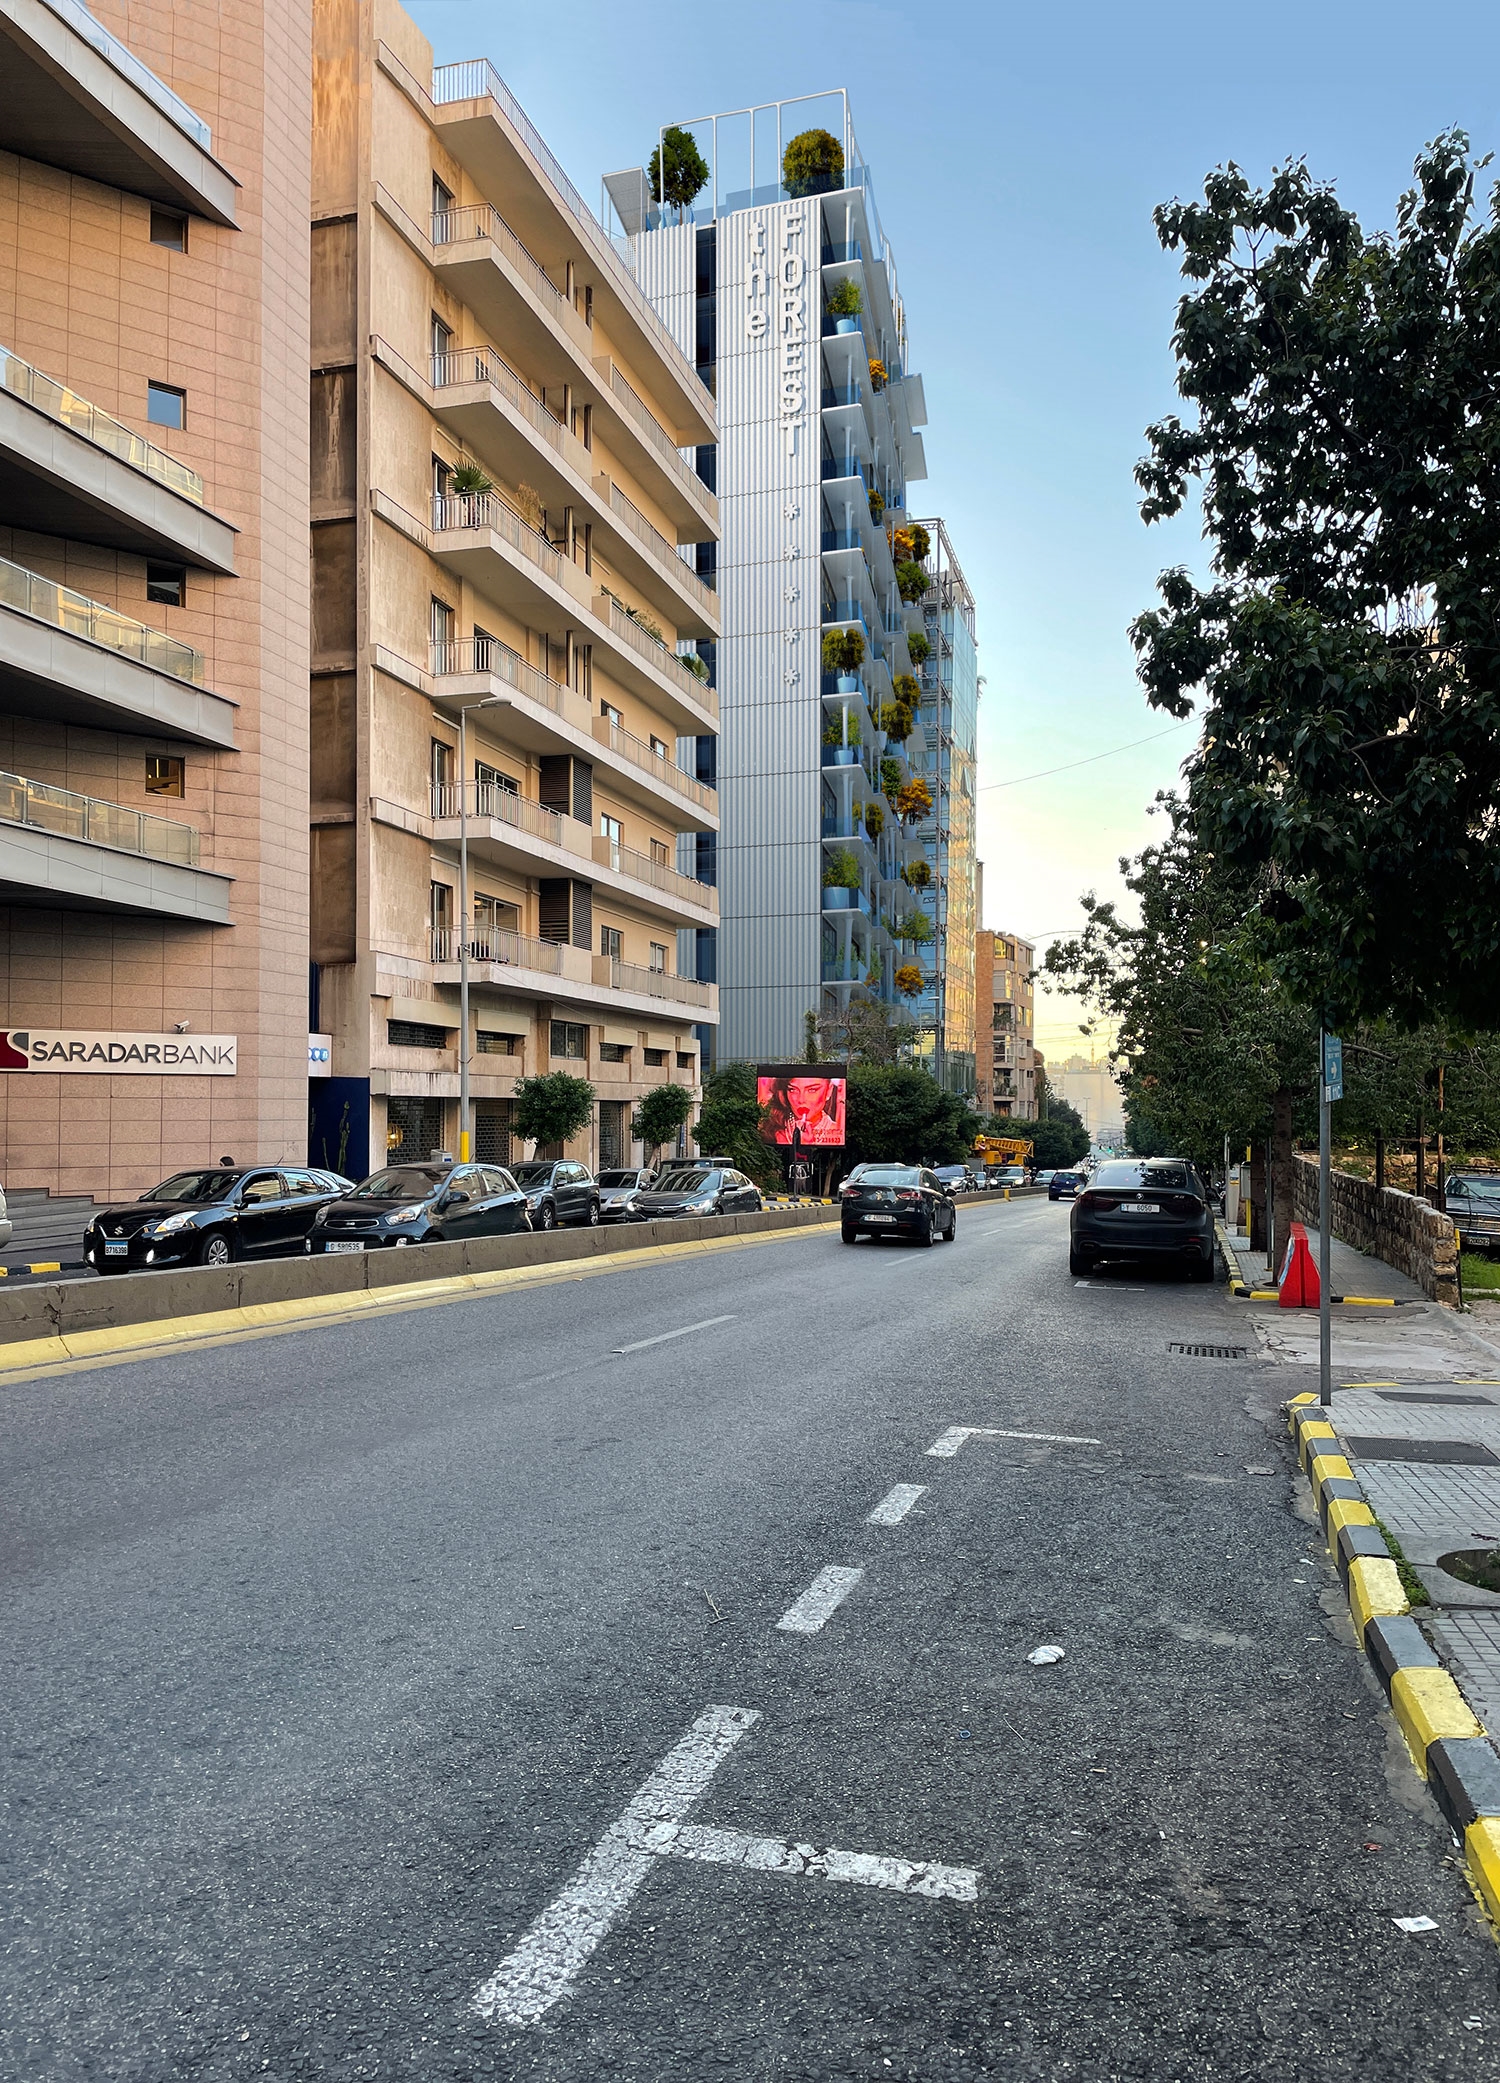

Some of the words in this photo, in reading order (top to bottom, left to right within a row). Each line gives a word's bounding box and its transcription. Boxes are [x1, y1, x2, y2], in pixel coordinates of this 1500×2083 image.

[746, 220, 767, 338] the
[779, 210, 805, 456] FOREST
[31, 1040, 234, 1065] SARADARBANK
